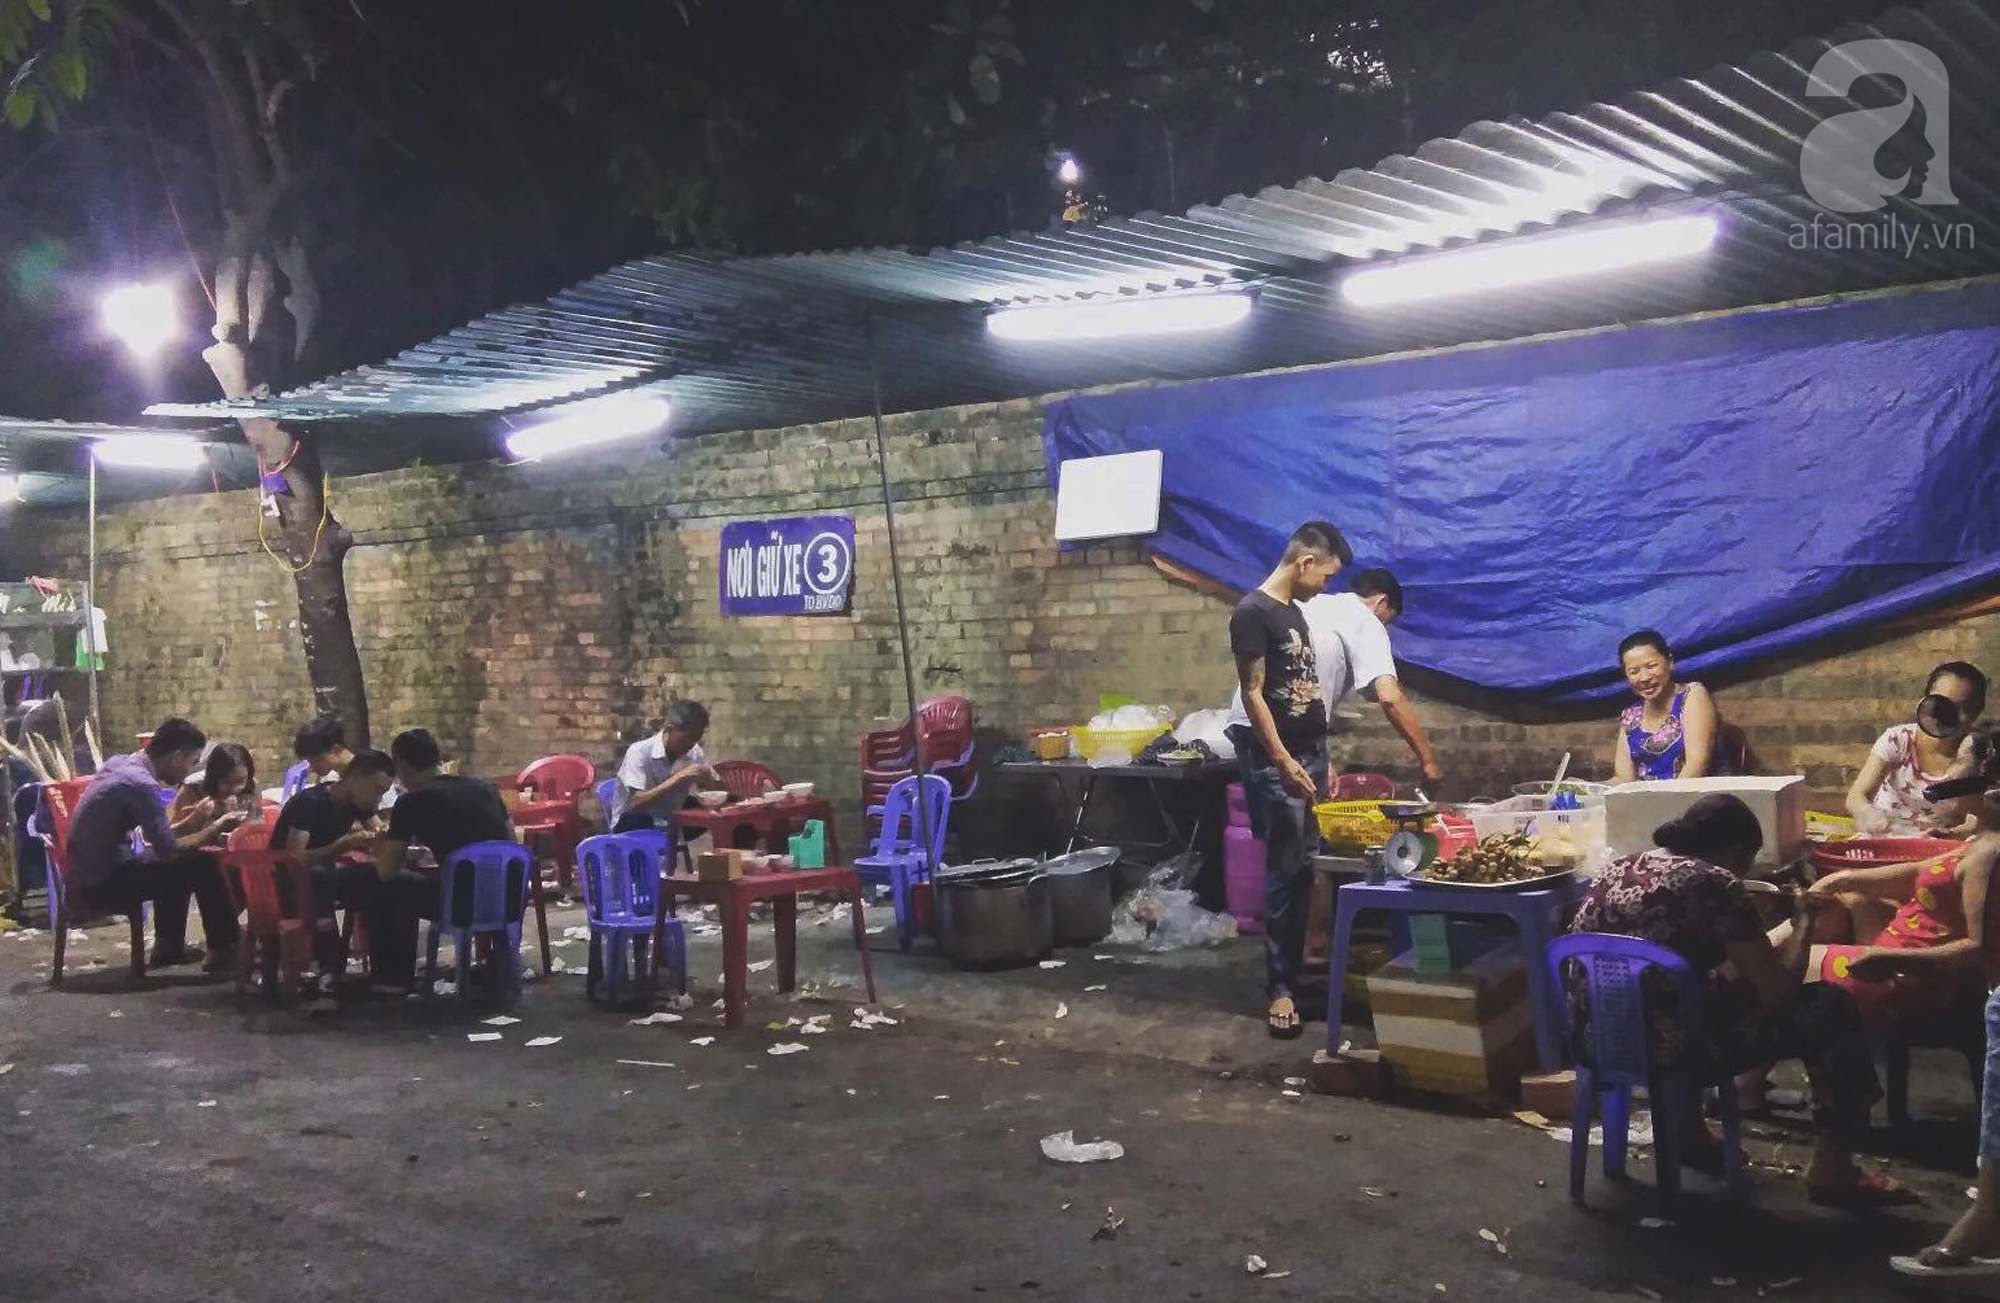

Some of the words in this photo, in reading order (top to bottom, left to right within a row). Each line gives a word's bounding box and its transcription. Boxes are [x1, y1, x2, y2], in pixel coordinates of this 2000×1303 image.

[756, 530, 783, 598] GIỮ
[783, 543, 802, 596] XE
[816, 543, 838, 583] 3
